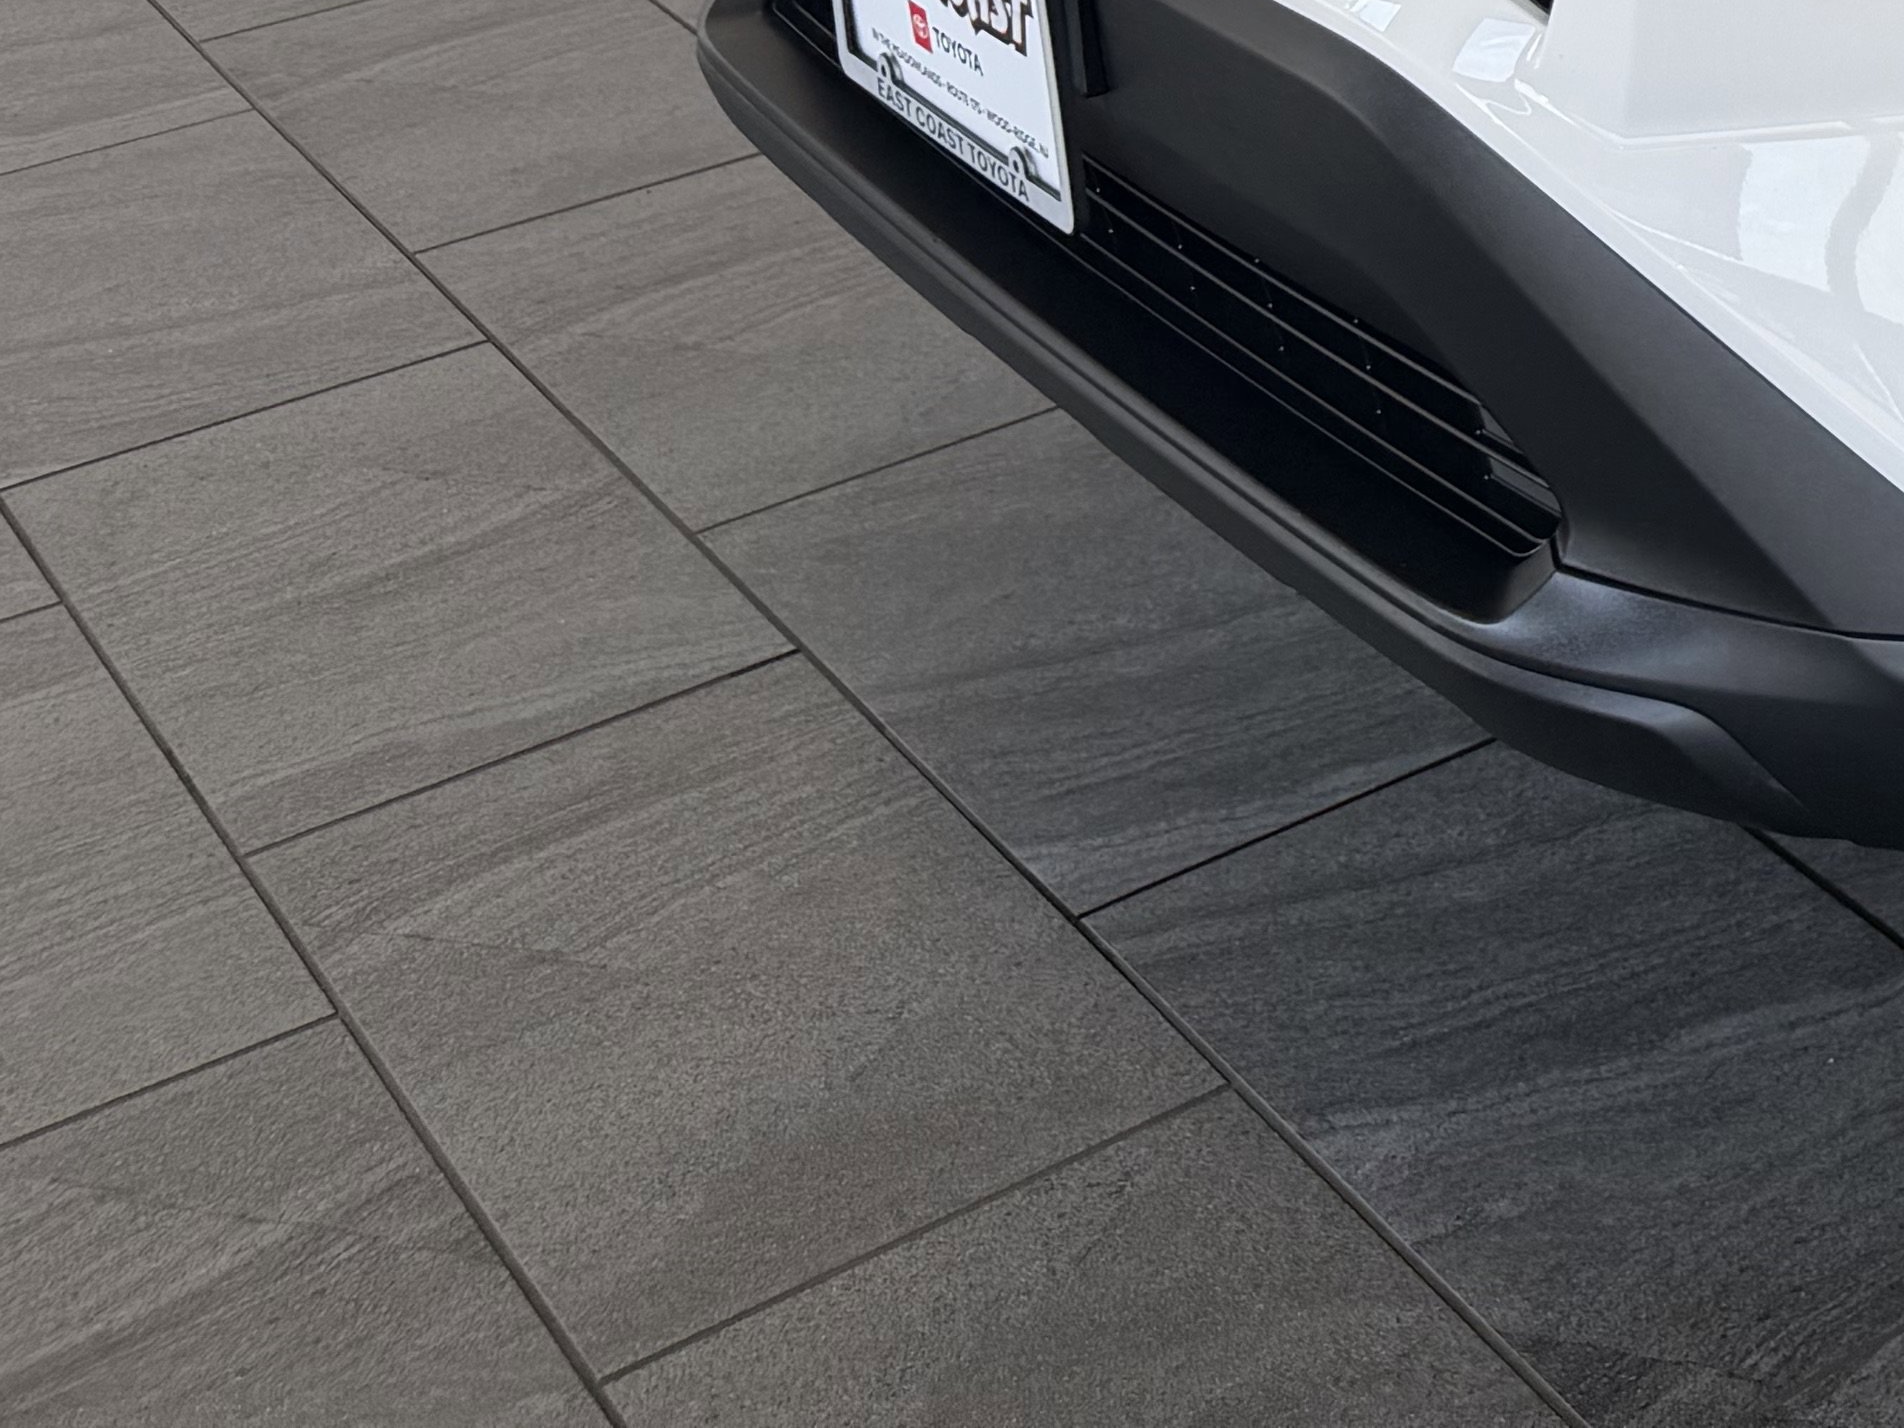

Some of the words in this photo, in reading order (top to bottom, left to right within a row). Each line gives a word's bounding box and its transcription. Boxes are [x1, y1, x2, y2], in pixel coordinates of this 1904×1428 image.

[932, 26, 984, 76] TOYOTA
[877, 76, 912, 117] EAST
[916, 106, 964, 155] COAST
[966, 140, 1030, 202] TOYOTA
